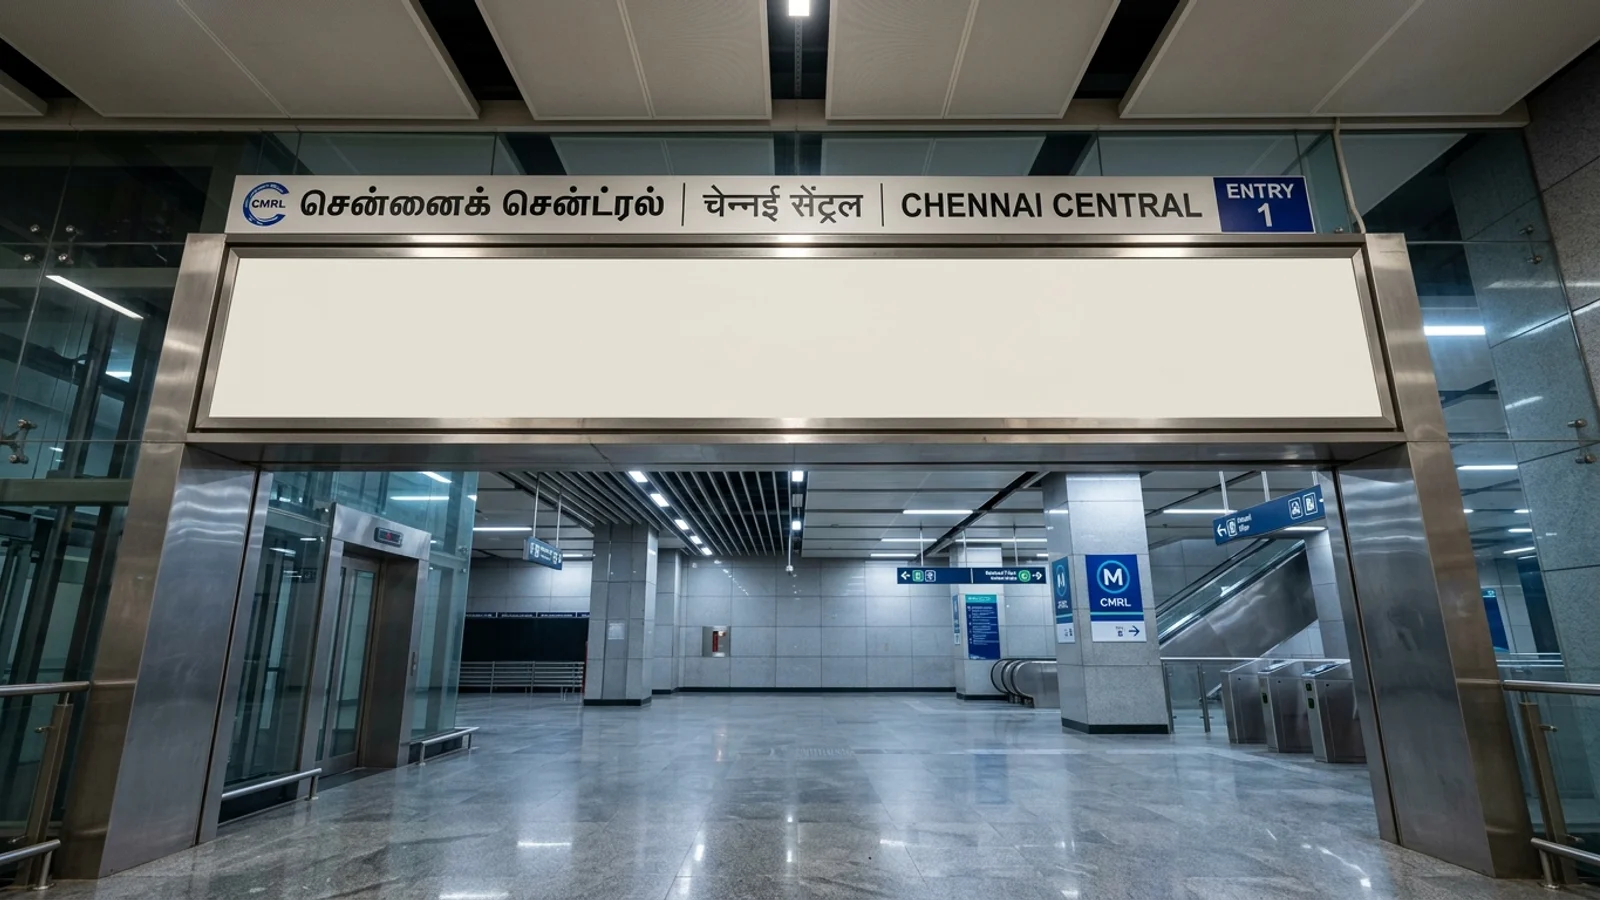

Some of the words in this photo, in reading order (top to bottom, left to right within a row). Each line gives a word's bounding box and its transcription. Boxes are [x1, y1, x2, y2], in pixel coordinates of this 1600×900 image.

[1226, 183, 1294, 199] ENTRY
[251, 199, 286, 208] CMRL
[300, 186, 491, 216] சென்னைக்
[502, 185, 665, 222] சென்ட்ரல்
[702, 184, 780, 222] चेन्नई
[789, 184, 864, 223] सेंट्रल
[901, 192, 1042, 218] CHENNAI
[1052, 192, 1203, 218] CENTRAL
[1257, 202, 1273, 228] 1
[1103, 568, 1123, 586] M
[1100, 597, 1131, 607] CMRL
